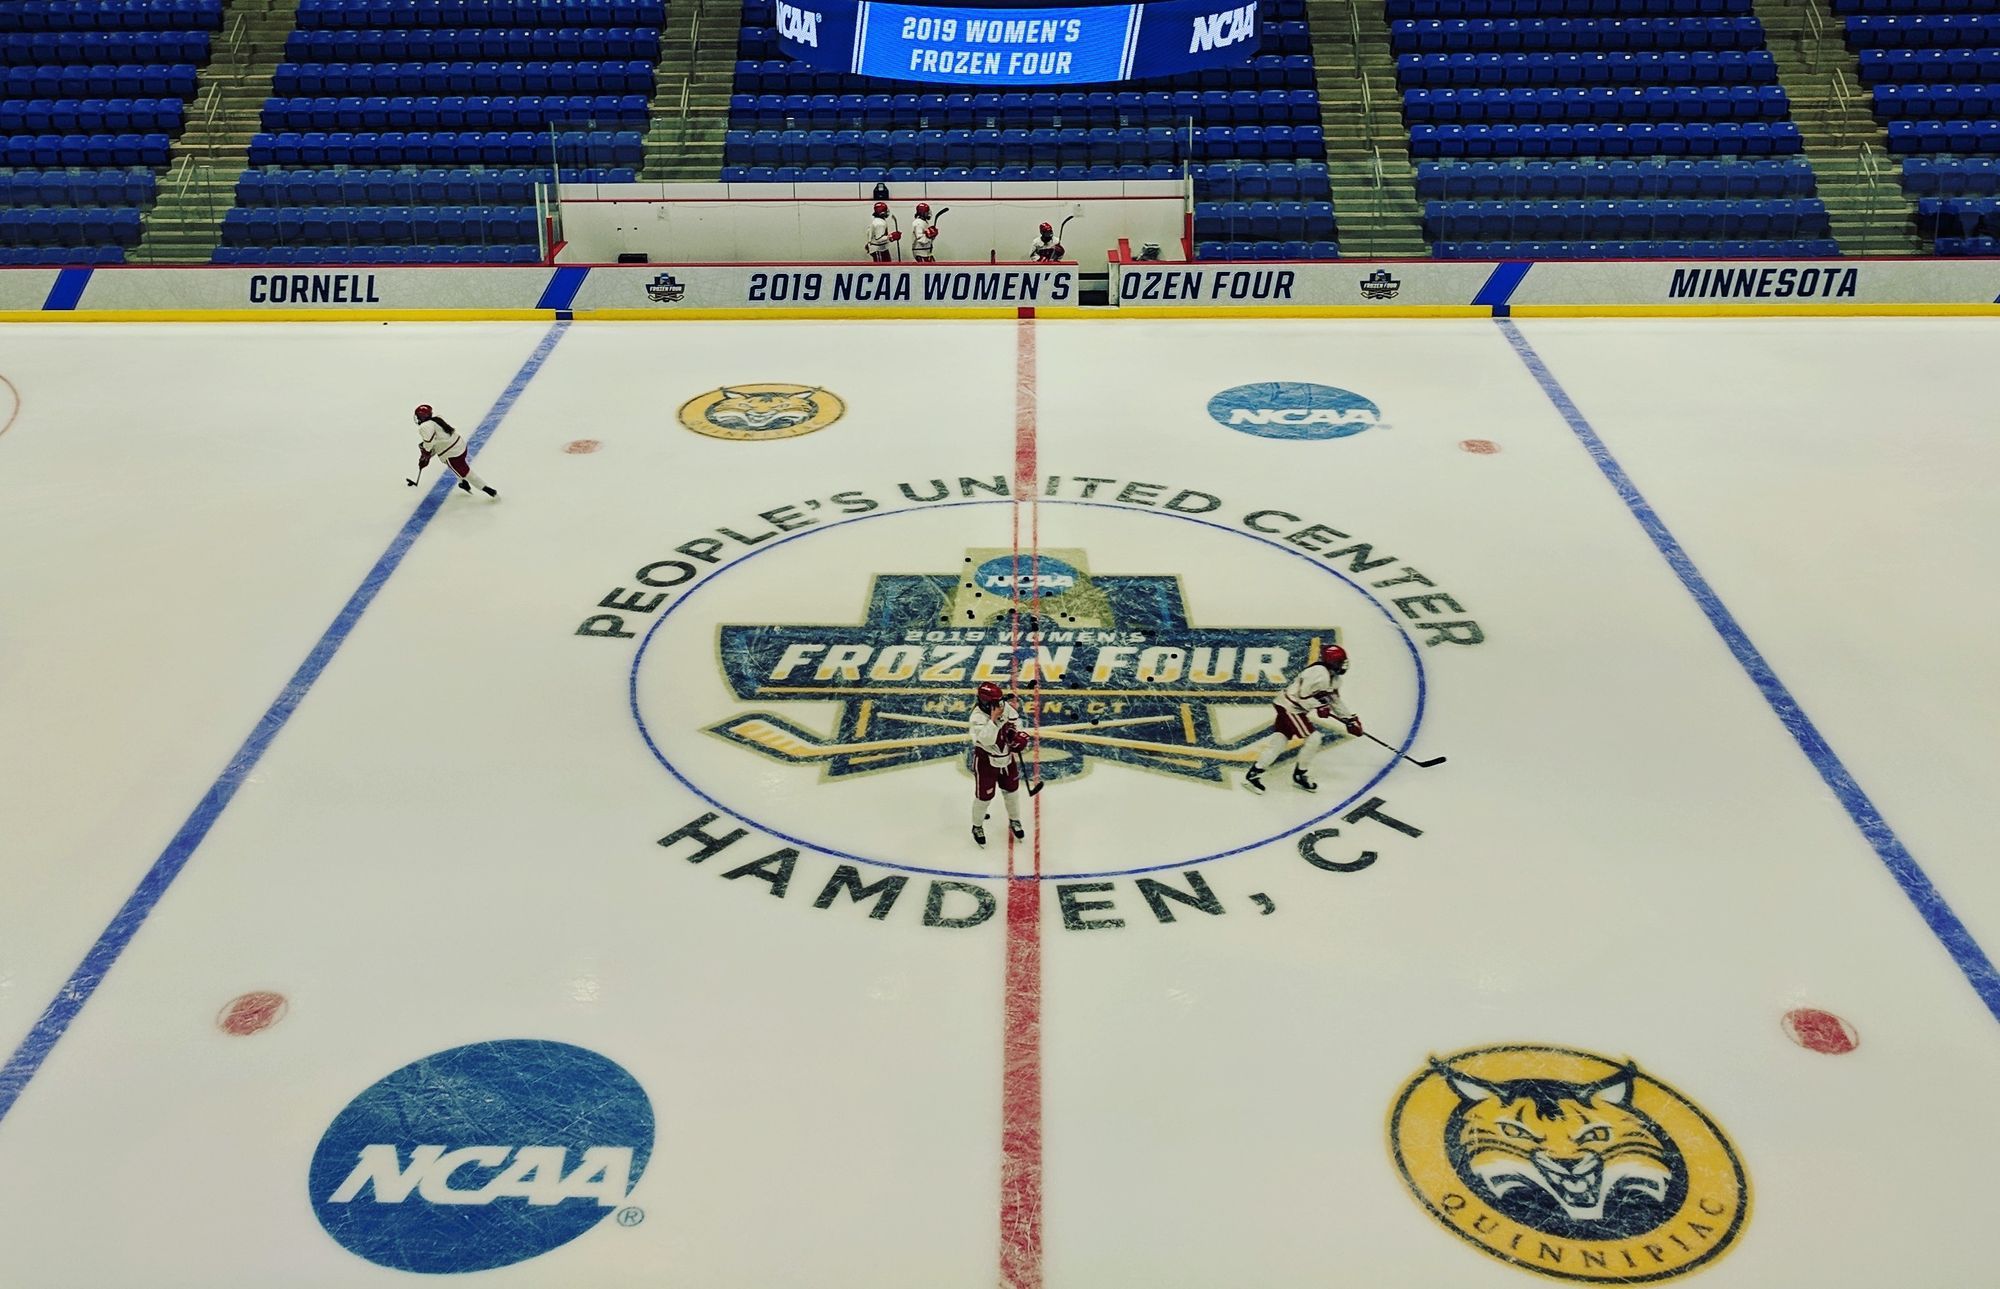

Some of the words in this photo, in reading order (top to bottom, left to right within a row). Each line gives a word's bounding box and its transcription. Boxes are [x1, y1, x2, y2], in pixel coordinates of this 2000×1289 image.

[901, 16, 958, 43] 2019
[965, 18, 1082, 44] WOMEN'S
[1189, 3, 1255, 54] NCAA
[910, 48, 1001, 75] FROZEN
[1007, 51, 1073, 76] FOUR
[249, 274, 380, 304] CORNELL
[749, 273, 822, 301] 2019
[832, 272, 911, 301] NCAA
[924, 272, 1072, 301] WOMEN'S
[1211, 271, 1295, 300] FOUR
[1668, 268, 1858, 298] MINNESOTA
[1229, 408, 1380, 426] NCAA
[573, 490, 880, 639] PEOPLE'S
[897, 474, 1222, 514] UNITED
[1243, 509, 1485, 648] CENTER
[903, 630, 986, 642] 2019
[999, 630, 1147, 643] WOMEN'S
[769, 643, 1075, 683] FROZEN
[1090, 646, 1290, 684] FOUR
[656, 812, 1276, 932] HAMDEN,
[1297, 796, 1424, 874] CT
[327, 1143, 635, 1207] NCAA
[1441, 1192, 1726, 1269] QUINNIPIAC
